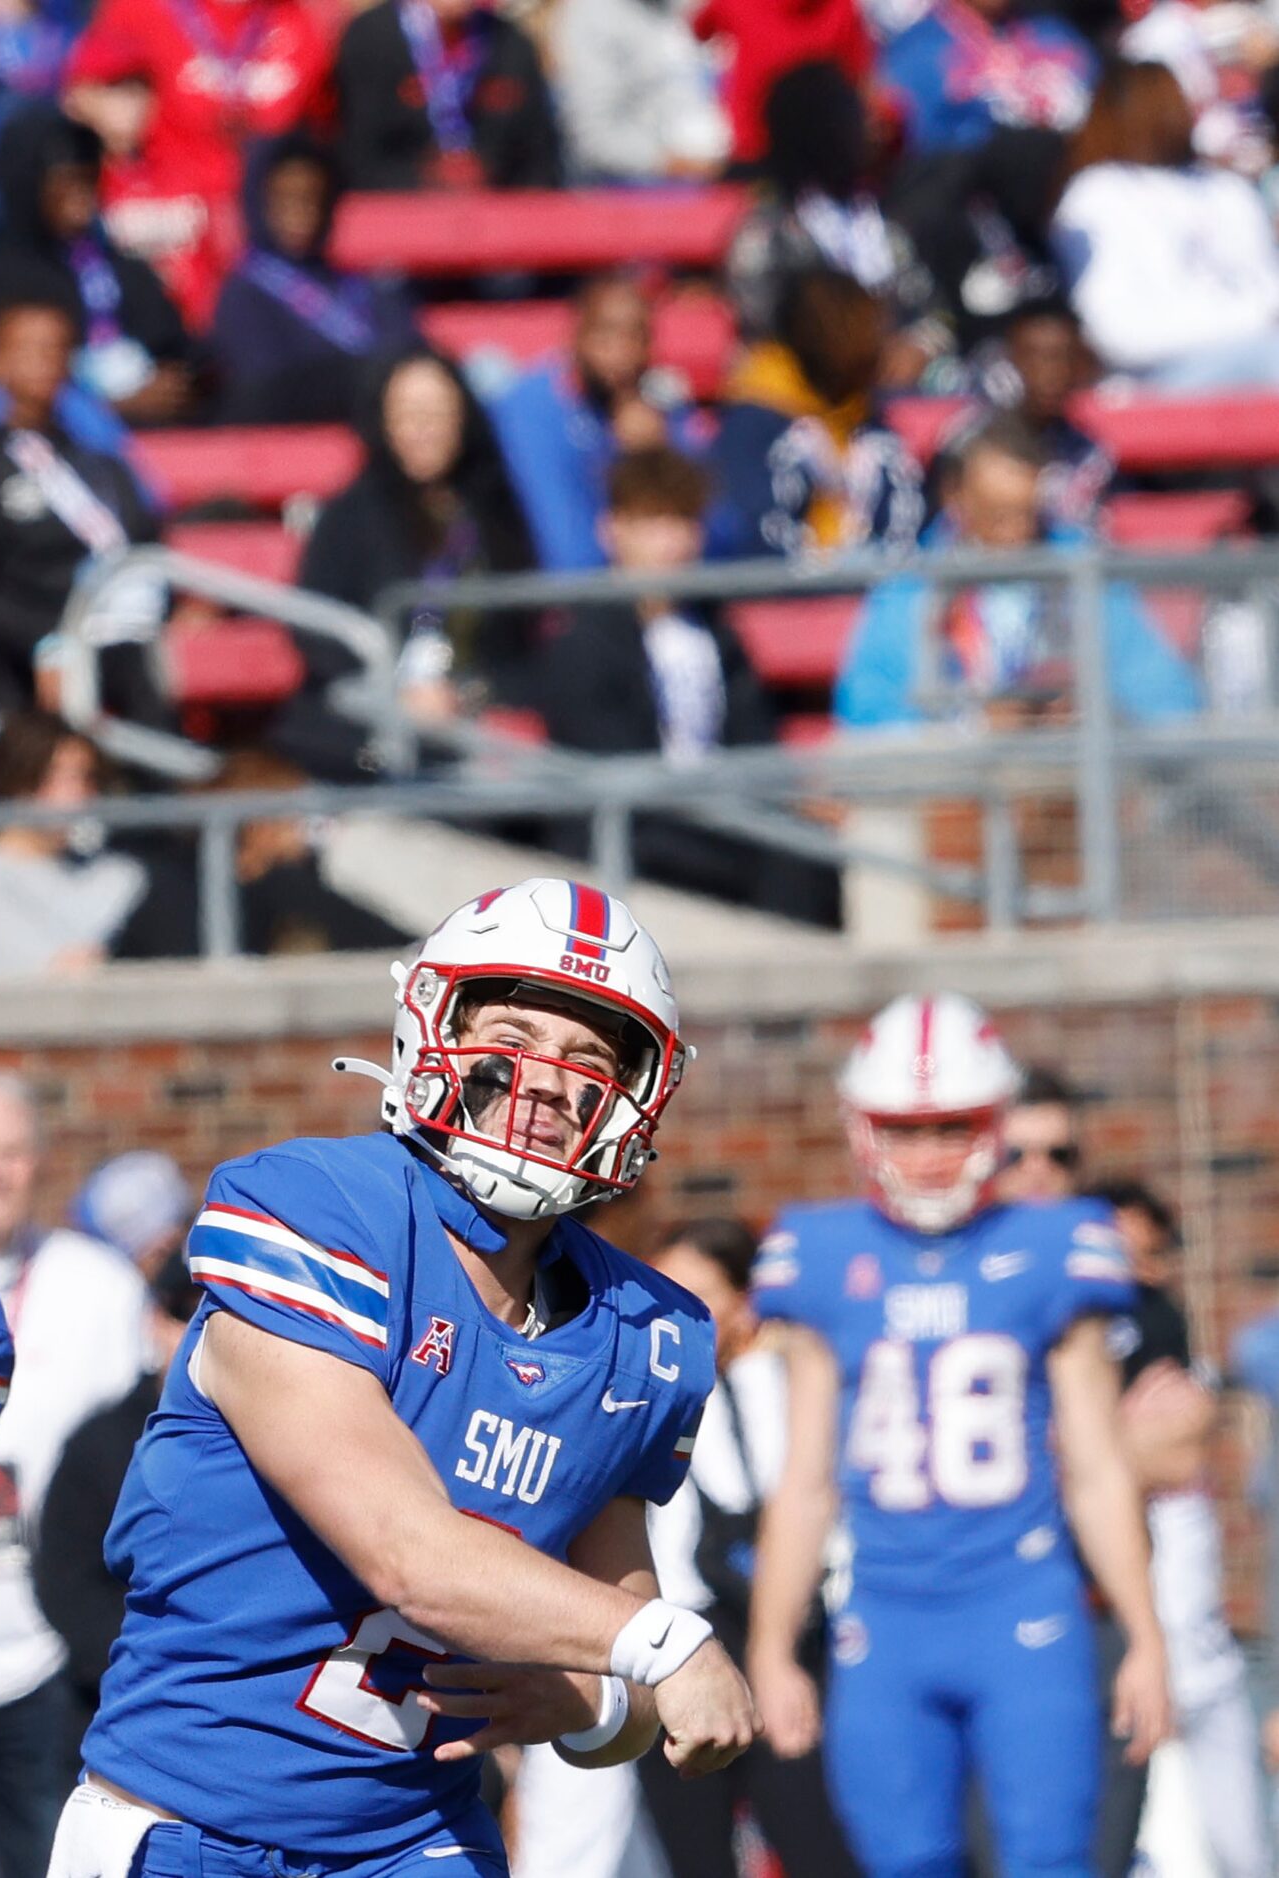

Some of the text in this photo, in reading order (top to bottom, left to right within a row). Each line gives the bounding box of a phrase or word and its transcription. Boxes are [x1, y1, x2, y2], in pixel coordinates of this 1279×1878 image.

[559, 954, 611, 983] SMU
[411, 1315, 455, 1376] A
[649, 1318, 681, 1383] C
[847, 1333, 1030, 1513] 48
[454, 1409, 562, 1505] SMU
